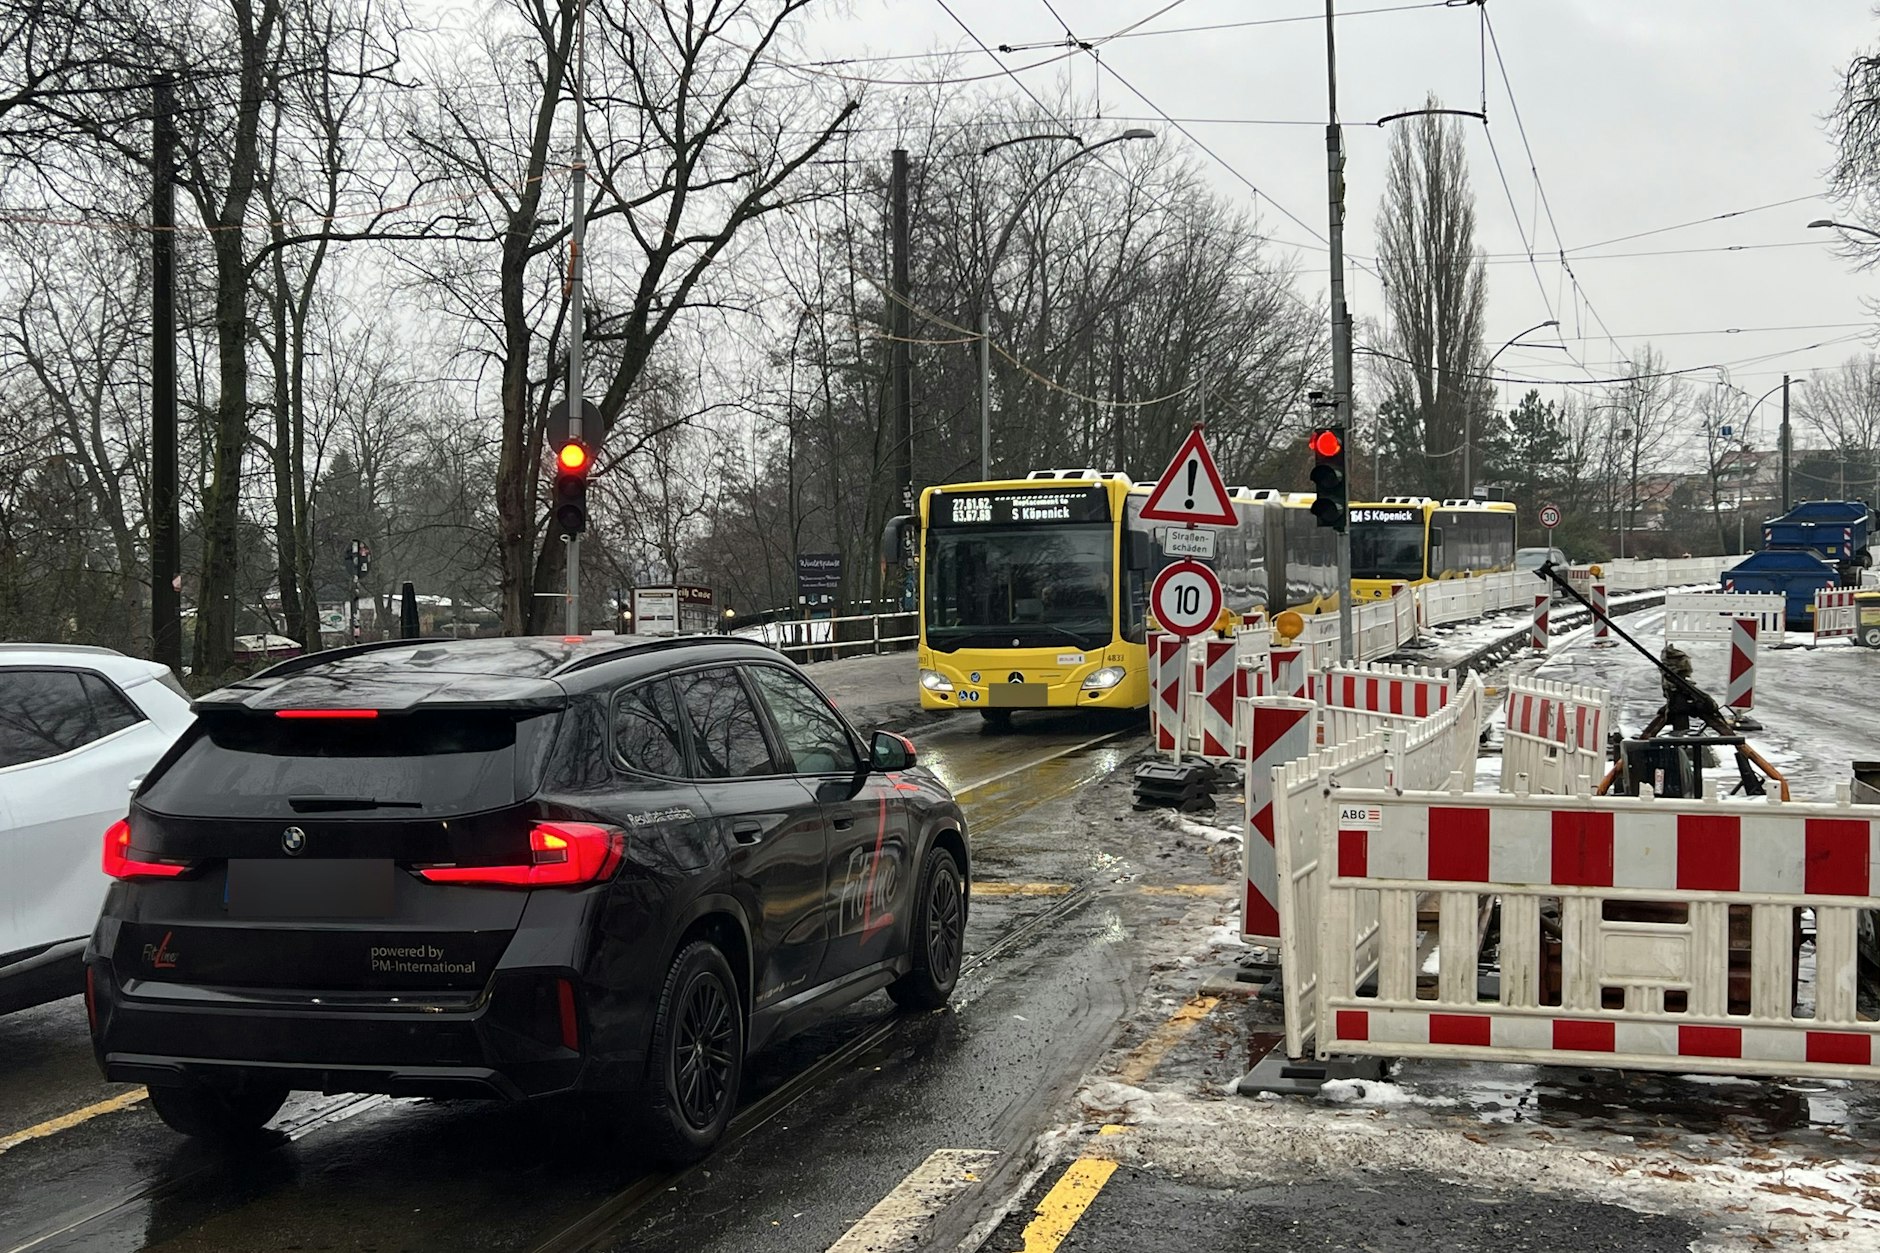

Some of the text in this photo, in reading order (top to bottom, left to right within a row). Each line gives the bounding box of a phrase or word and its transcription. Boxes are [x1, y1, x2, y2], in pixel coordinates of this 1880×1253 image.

[1011, 505, 1070, 520] S Köpenick
[1363, 510, 1371, 521] S
[1372, 510, 1413, 523] Köpenick
[1543, 512, 1556, 522] 30
[1172, 531, 1209, 542] Straßen-
[1172, 543, 1208, 553] schäden
[1174, 584, 1200, 615] 10
[1341, 809, 1366, 820] ABG
[371, 945, 445, 961] powered by
[372, 960, 476, 974] PM-International
